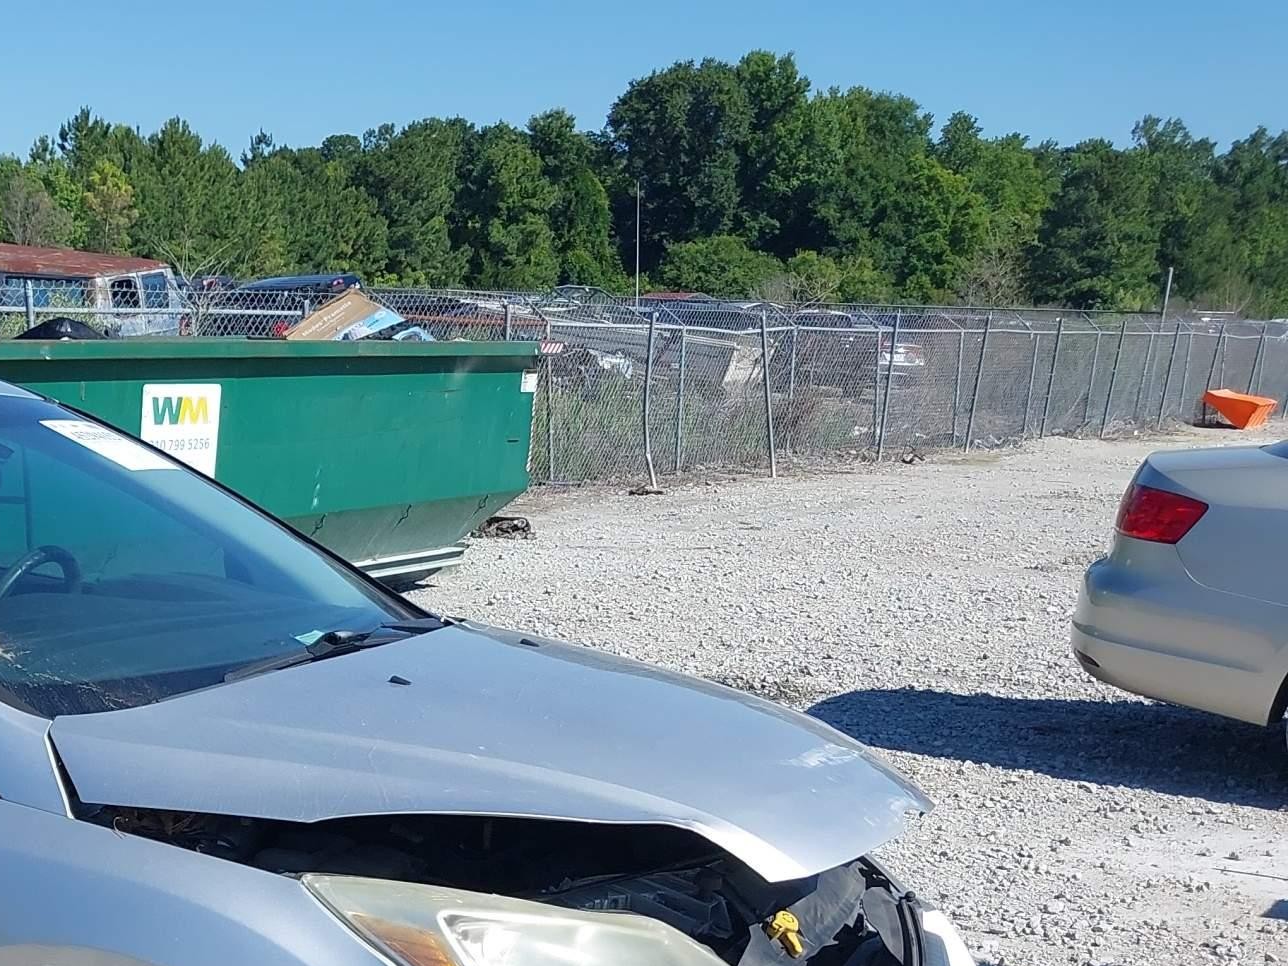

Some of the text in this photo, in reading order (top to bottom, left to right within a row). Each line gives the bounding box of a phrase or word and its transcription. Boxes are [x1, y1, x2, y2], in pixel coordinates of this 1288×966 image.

[152, 397, 209, 425] WM
[168, 439, 185, 451] 799
[188, 438, 210, 450] 5256
